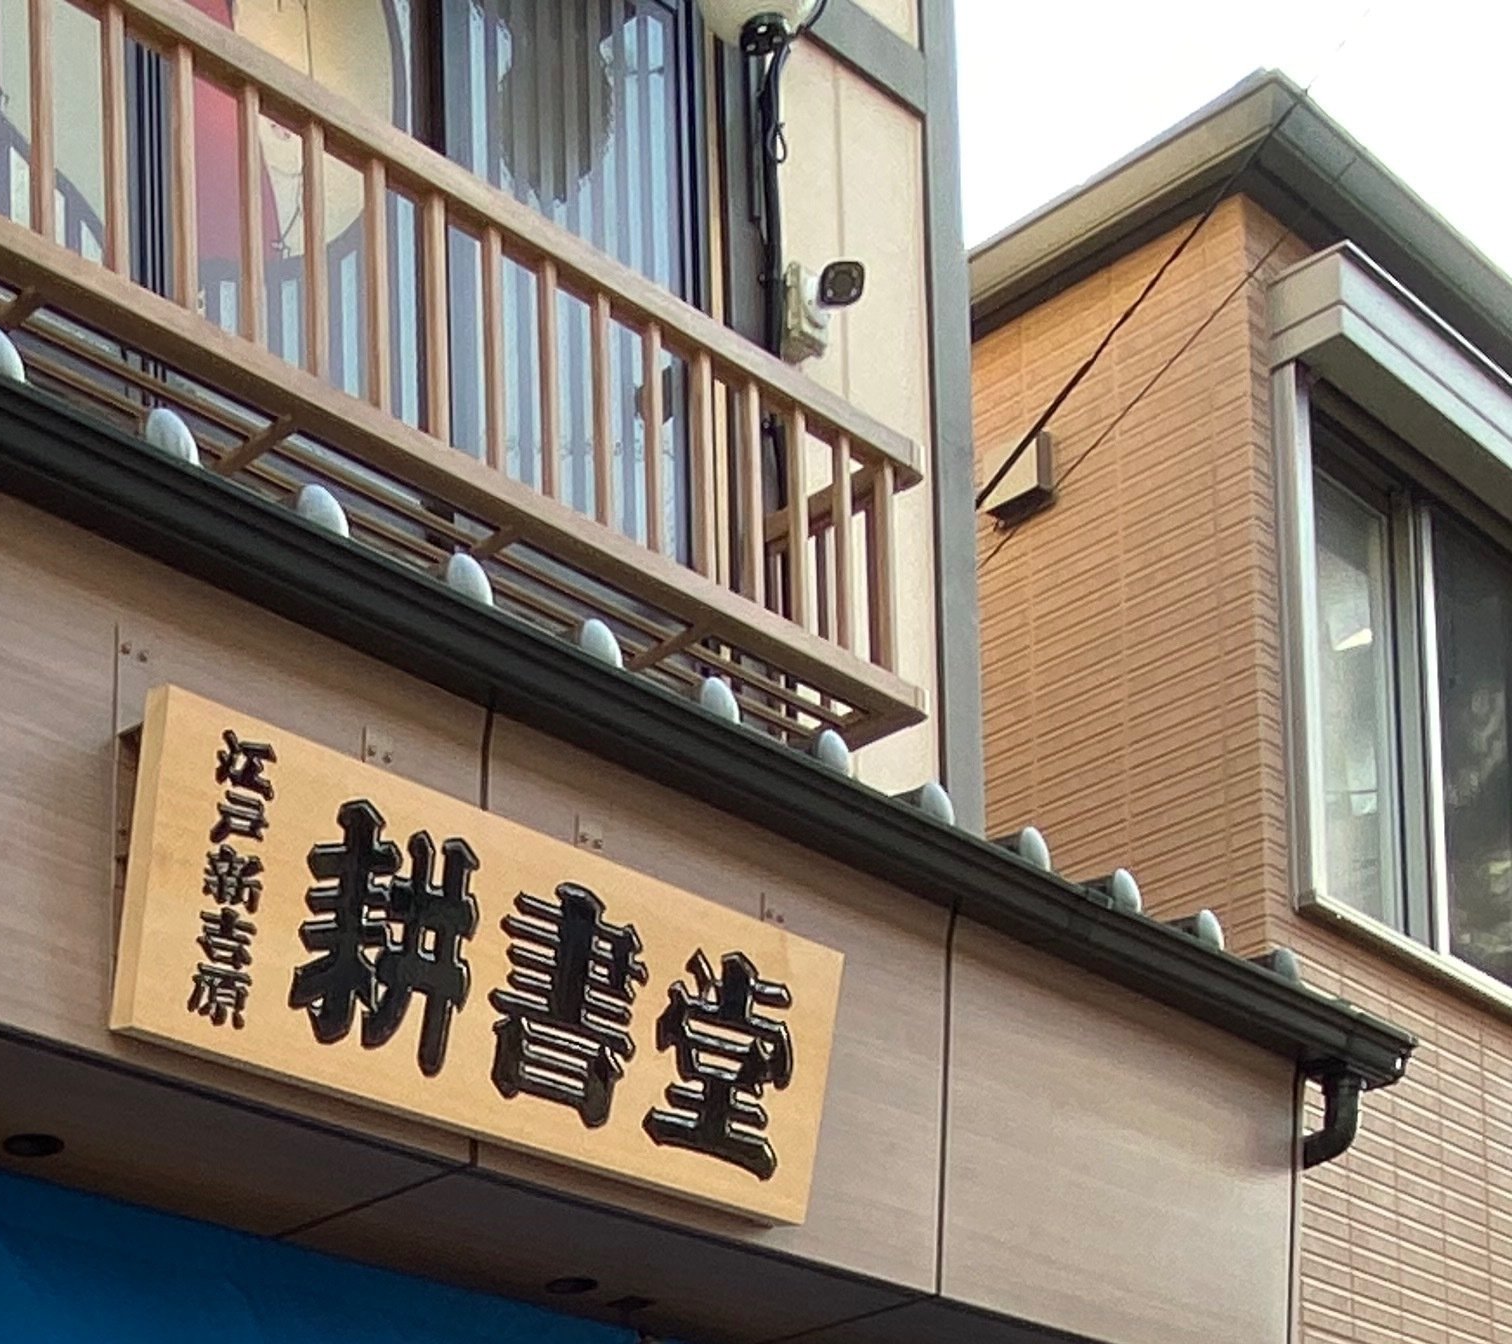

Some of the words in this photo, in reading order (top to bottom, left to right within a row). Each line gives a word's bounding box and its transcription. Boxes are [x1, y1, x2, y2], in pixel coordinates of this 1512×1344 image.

[186, 729, 278, 1030] 江戸新吉原
[288, 798, 794, 1181] 耕書堂
